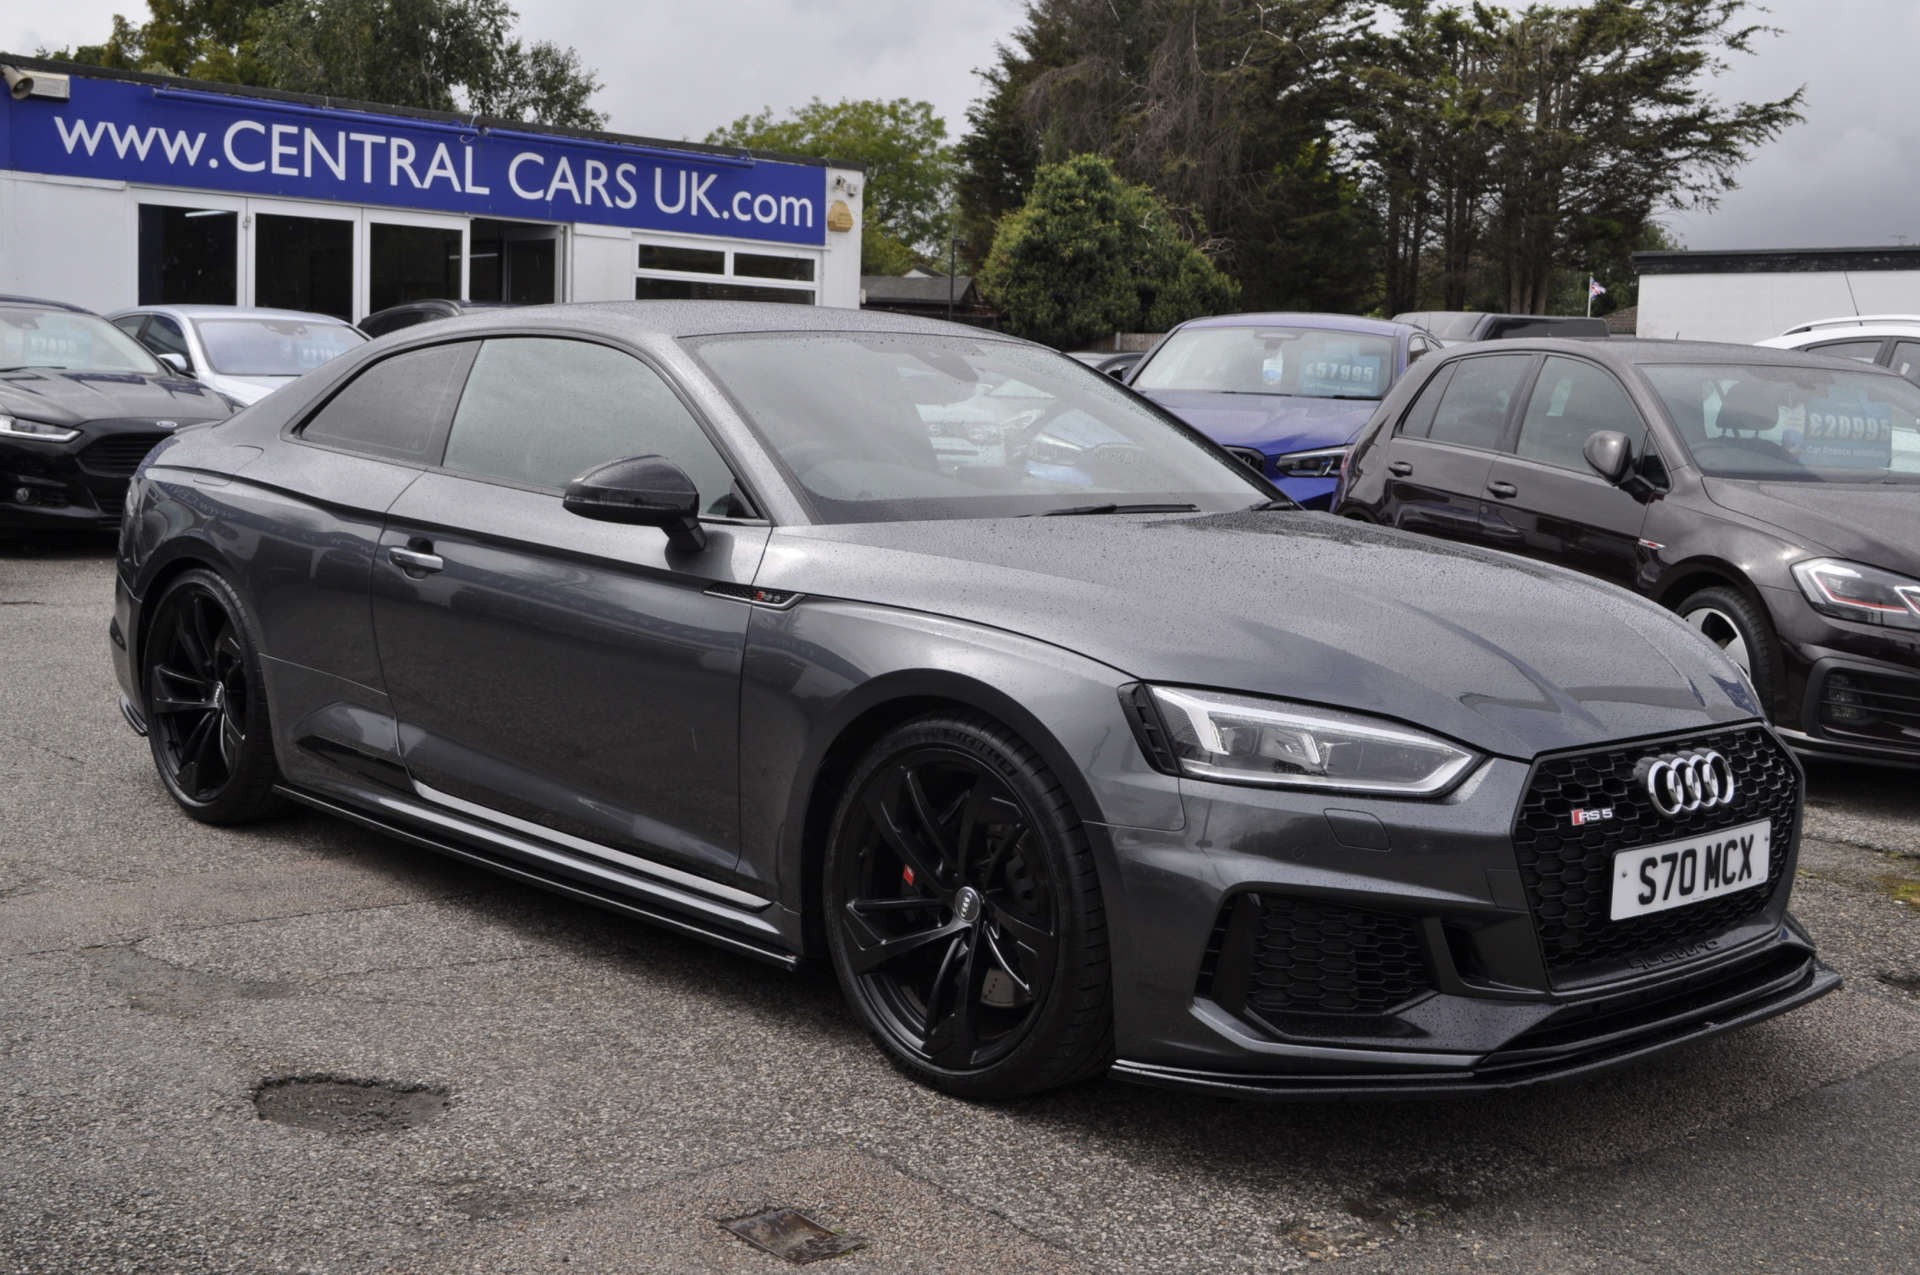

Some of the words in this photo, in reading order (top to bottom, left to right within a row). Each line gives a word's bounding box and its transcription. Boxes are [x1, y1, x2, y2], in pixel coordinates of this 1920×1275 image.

[508, 152, 637, 210] CARS
[655, 167, 813, 228] UK.com
[1808, 413, 1890, 440] £20995
[1638, 848, 1697, 905] S70
[1704, 834, 1754, 891] MCX
